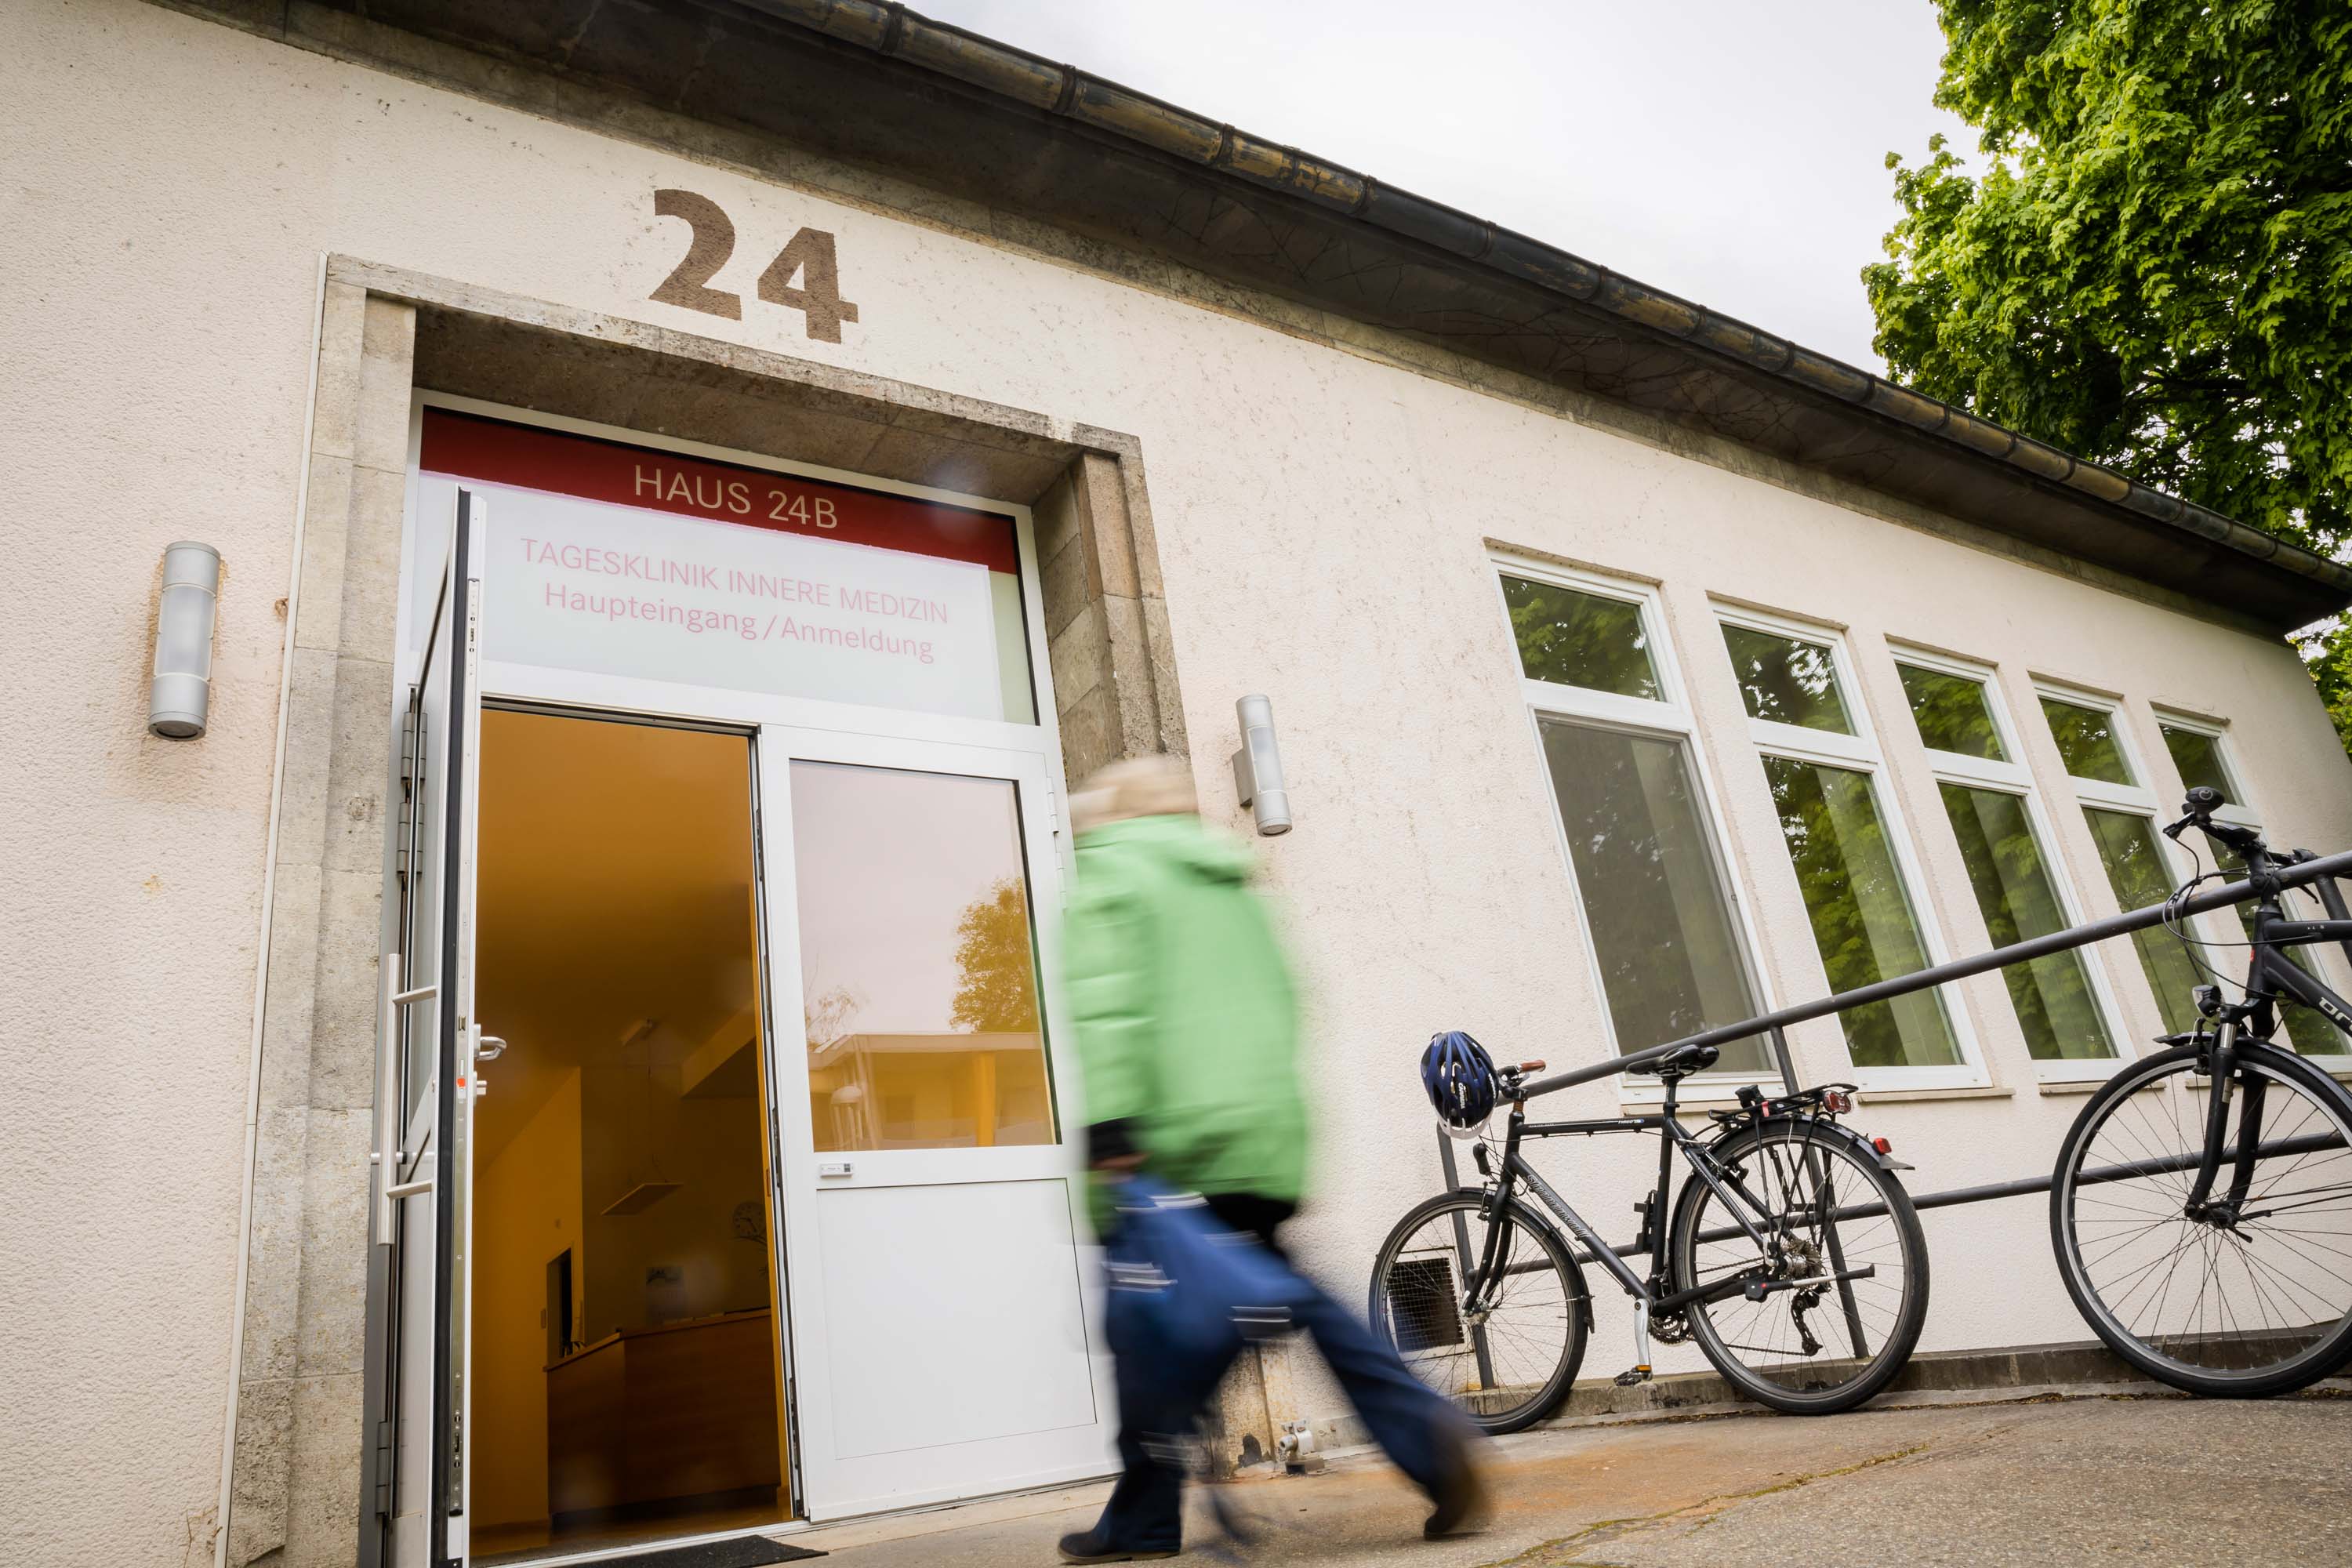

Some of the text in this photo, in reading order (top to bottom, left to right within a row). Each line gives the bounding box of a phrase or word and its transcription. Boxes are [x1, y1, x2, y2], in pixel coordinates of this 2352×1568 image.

[648, 188, 858, 344] 24
[636, 465, 837, 529] HAUS 24B
[521, 538, 947, 624] TAGESKLINIK INNERE MEDIZIN
